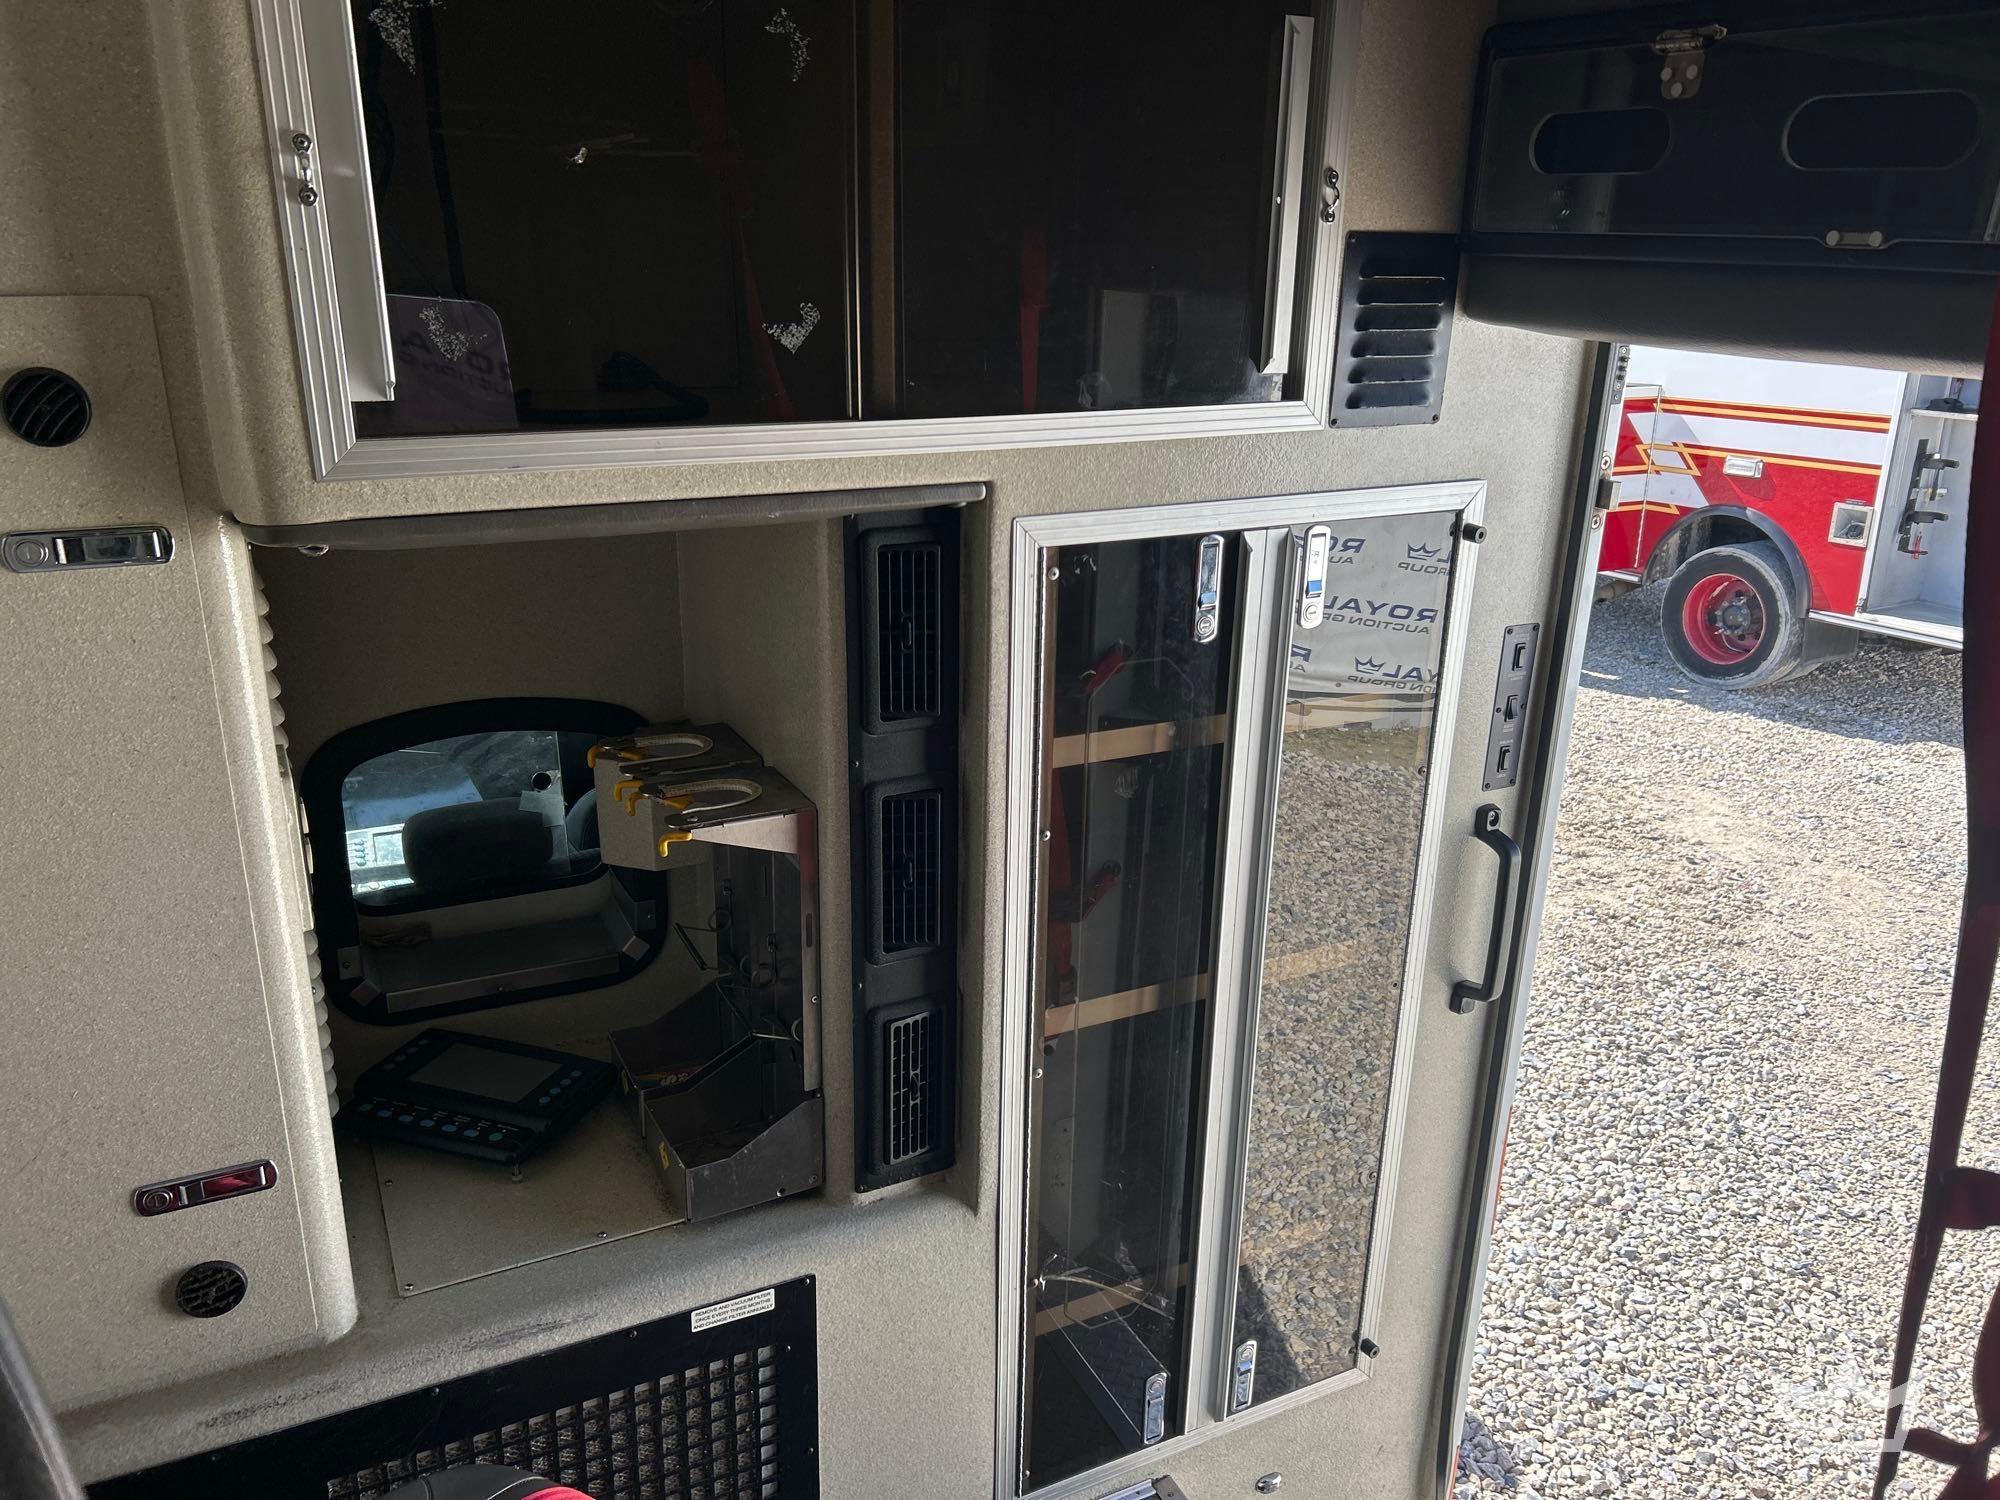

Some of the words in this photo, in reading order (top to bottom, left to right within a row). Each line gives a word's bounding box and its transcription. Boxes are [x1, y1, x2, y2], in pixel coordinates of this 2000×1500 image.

[695, 1307, 718, 1317] REMOVE
[731, 1297, 753, 1307] VACUUM
[753, 1292, 771, 1300] FILTER
[695, 1315, 711, 1323] ONCE
[712, 1310, 729, 1319] EVERY
[730, 1305, 747, 1313] THREE
[748, 1298, 771, 1308] MONTHS
[705, 1317, 728, 1326] CHANGE
[729, 1311, 746, 1320] FILTER
[746, 1304, 774, 1315] ANNUALLY
